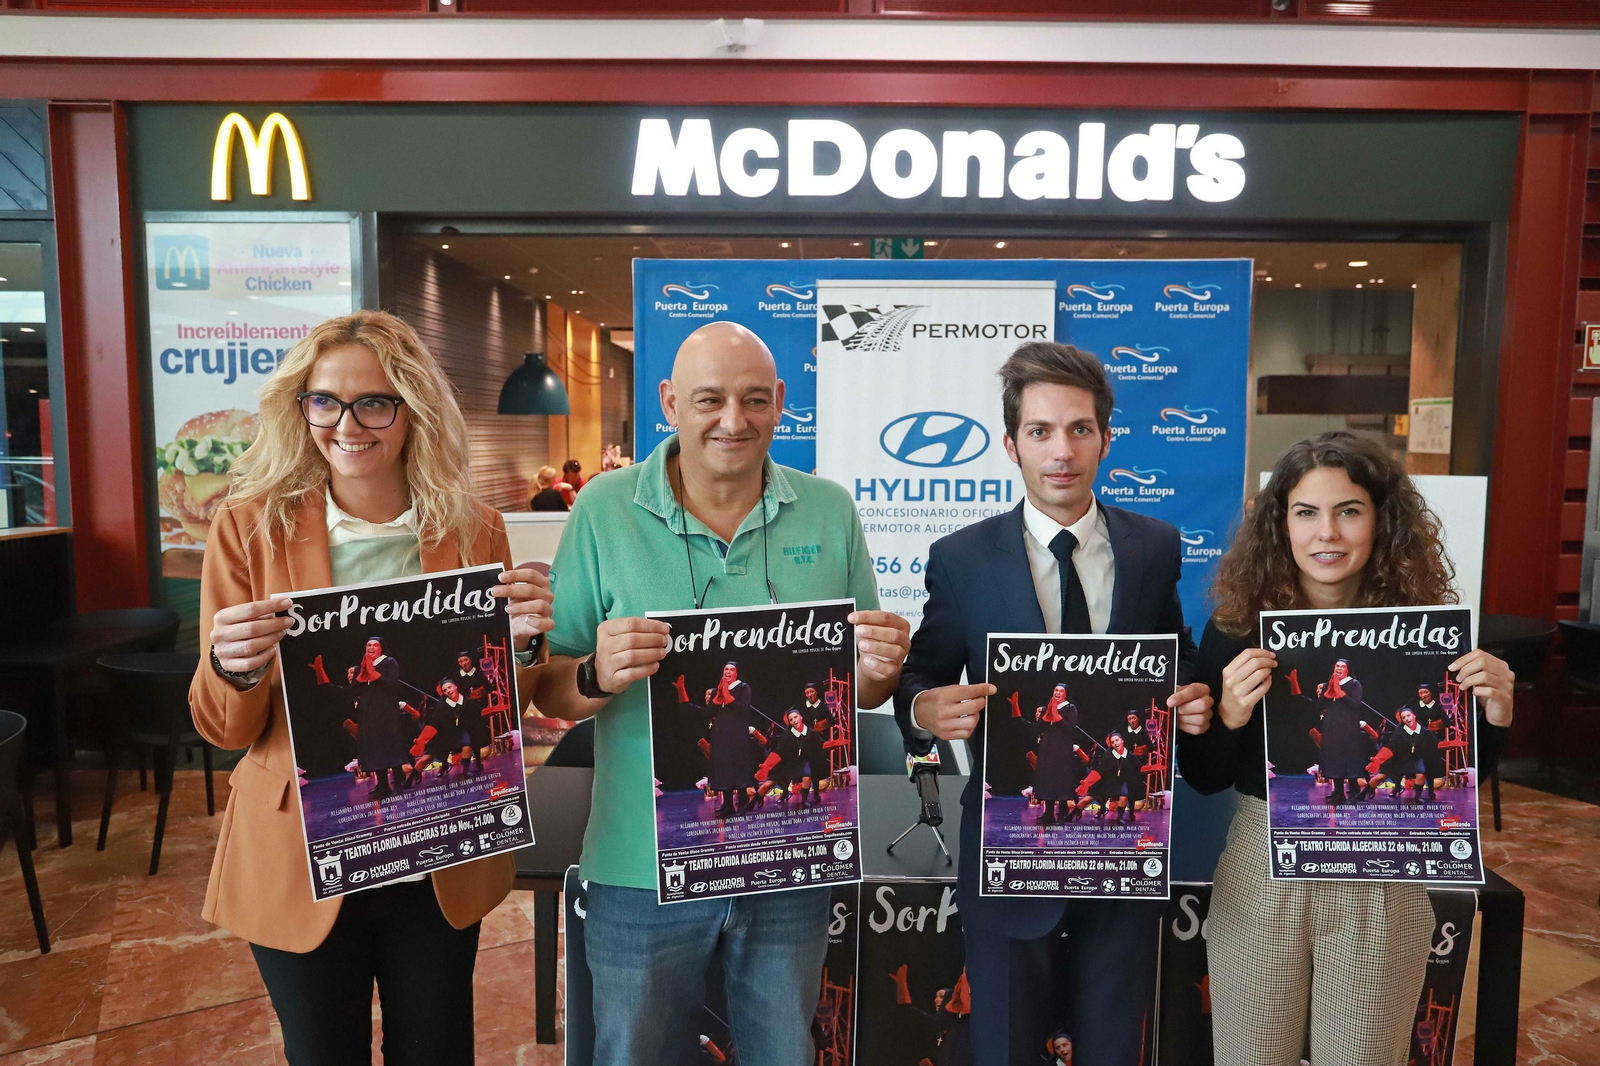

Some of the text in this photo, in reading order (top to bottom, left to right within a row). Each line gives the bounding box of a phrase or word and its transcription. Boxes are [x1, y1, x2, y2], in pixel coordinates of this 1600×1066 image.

[632, 119, 1245, 202] McDonald's
[252, 245, 302, 258] Nueva
[245, 276, 312, 291] Chicken
[655, 302, 728, 313] Puerta Europa
[758, 302, 817, 311] Puerta Euro
[1059, 302, 1133, 314] Puerta Europa
[1155, 302, 1230, 314] Puerta Europa
[177, 321, 315, 339] Increíblement
[912, 323, 1048, 339] PERMOTOR
[159, 342, 290, 385] crujie
[1104, 363, 1178, 376] Puerta Europa
[656, 424, 678, 433] Puer
[796, 424, 817, 433] Euro
[1152, 425, 1227, 437] Puerta Europa
[855, 478, 1012, 503] HYUNDAI
[1101, 486, 1175, 498] Puerta Europa
[859, 507, 959, 518] CONCESIONARIO
[863, 523, 921, 533] ERMOTOR
[782, 544, 822, 556] HILFIGER
[1186, 546, 1222, 559] Europa
[870, 556, 902, 574] 56
[286, 578, 496, 637] SorPrendidas
[1268, 614, 1463, 651] SorPrendidas
[993, 642, 1169, 678] SorPrendidas
[344, 843, 371, 859] TEATRO
[373, 836, 401, 852] FLORIDA
[403, 826, 439, 845] ALGECIRAS
[440, 824, 448, 836] 22
[449, 823, 457, 833] de
[474, 813, 494, 827] 21.00h
[490, 827, 523, 840] COLOMER
[497, 837, 519, 845] DENTAL
[1300, 841, 1323, 851] TEATRO
[1325, 841, 1351, 851] FLORIDA
[1352, 841, 1386, 851] ALGECIRAS
[1388, 841, 1396, 852] 22
[1397, 841, 1404, 852] de
[1422, 842, 1442, 852] 21.00h
[689, 858, 713, 870] TEATRO
[714, 855, 740, 867] FLORIDA
[741, 851, 774, 864] ALGECIRAS
[775, 849, 783, 860] 22
[784, 849, 791, 859] de
[808, 845, 827, 857] 21.00h
[370, 859, 408, 874] HYUNDAI
[821, 861, 853, 872] COLOMER
[1009, 860, 1031, 869] TEATRO
[1032, 860, 1055, 869] FLORIDA
[1057, 860, 1088, 870] ALGECIRAS
[1089, 860, 1096, 870] 22
[1097, 860, 1104, 870] de
[1119, 860, 1137, 870] 21.00h
[1436, 860, 1472, 869] COLOMER
[371, 864, 410, 878] PERMOTOR
[709, 877, 744, 887] HYUNDAI
[710, 882, 745, 891] PERMOTOR
[1130, 877, 1161, 886] COLOMER
